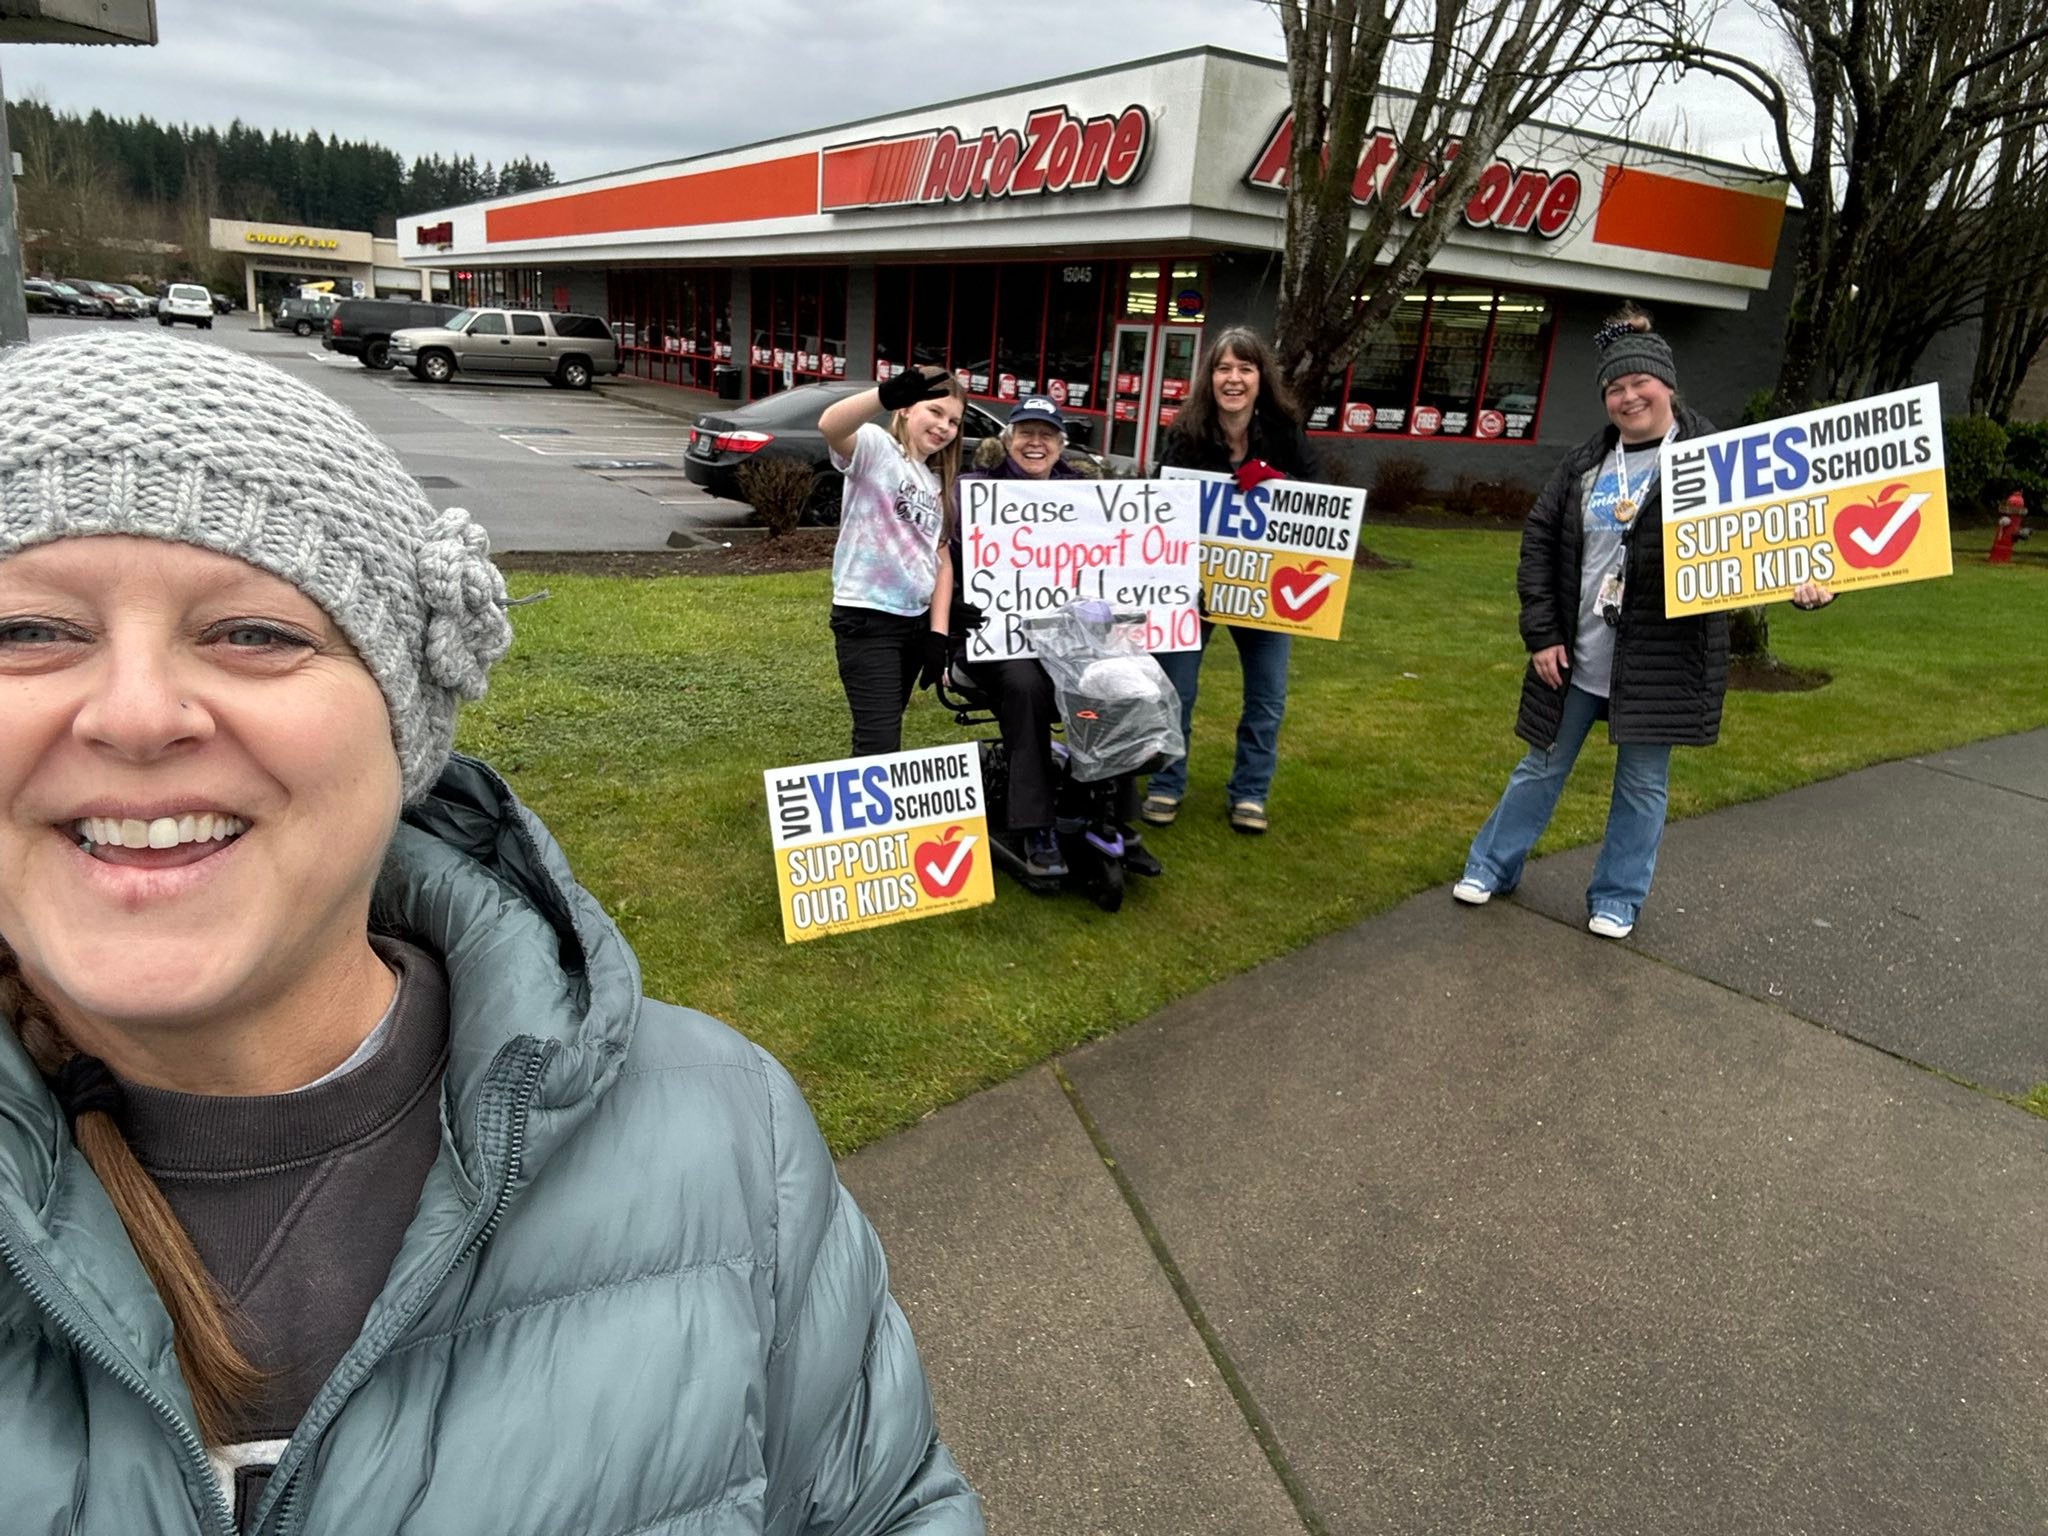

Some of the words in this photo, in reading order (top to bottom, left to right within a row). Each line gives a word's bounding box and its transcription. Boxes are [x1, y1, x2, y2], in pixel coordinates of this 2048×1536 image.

[919, 106, 1148, 201] AutoZone
[245, 232, 338, 249] GOODYEAR
[1063, 267, 1093, 282] 15045
[1810, 399, 1922, 448] MONROE
[1672, 448, 1706, 514] VOTE
[1707, 426, 1810, 504] YES
[1812, 436, 1931, 484] SCHOOLS
[970, 482, 1079, 525] Please
[1096, 483, 1176, 523] Vote
[1200, 480, 1270, 541] YES
[1271, 489, 1352, 520] MONROE
[1676, 495, 1828, 560] SUPPORT
[968, 526, 1000, 569] to
[1010, 526, 1134, 588] Support
[1142, 525, 1196, 566] Our
[1266, 520, 1350, 551] SCHOOLS
[1200, 545, 1273, 583] PPORT
[1676, 557, 1742, 603] OUR
[1753, 542, 1834, 591] KIDS
[970, 569, 1082, 613] School
[1210, 582, 1268, 619] KIDS
[974, 616, 995, 657] &
[1170, 608, 1199, 650] 10
[890, 754, 969, 789] MONROE
[776, 776, 812, 840] VOTE
[807, 765, 893, 834] YES
[894, 787, 977, 821] SCHOOLS
[788, 832, 909, 887] SUPPORT
[792, 885, 848, 929] OUR
[855, 873, 918, 917] KIDS
